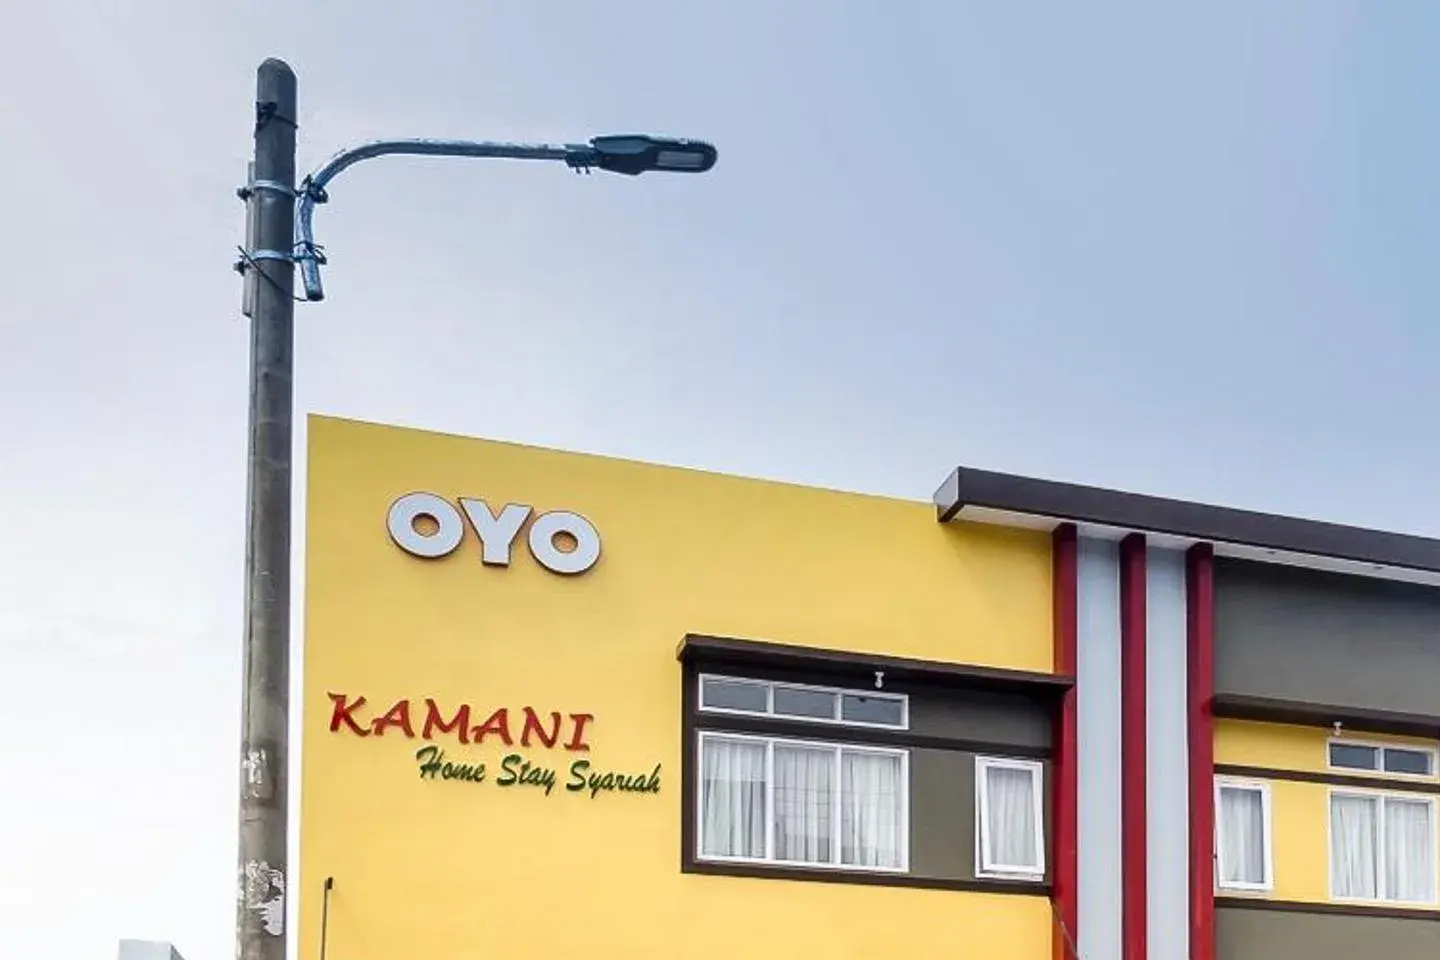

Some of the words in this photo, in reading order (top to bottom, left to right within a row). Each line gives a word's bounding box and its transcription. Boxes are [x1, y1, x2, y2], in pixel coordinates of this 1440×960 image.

[387, 491, 601, 574] OYO
[328, 691, 593, 751] KAMANI
[417, 745, 486, 782] Home
[497, 753, 556, 796] Stay
[565, 760, 662, 799] Syariah
